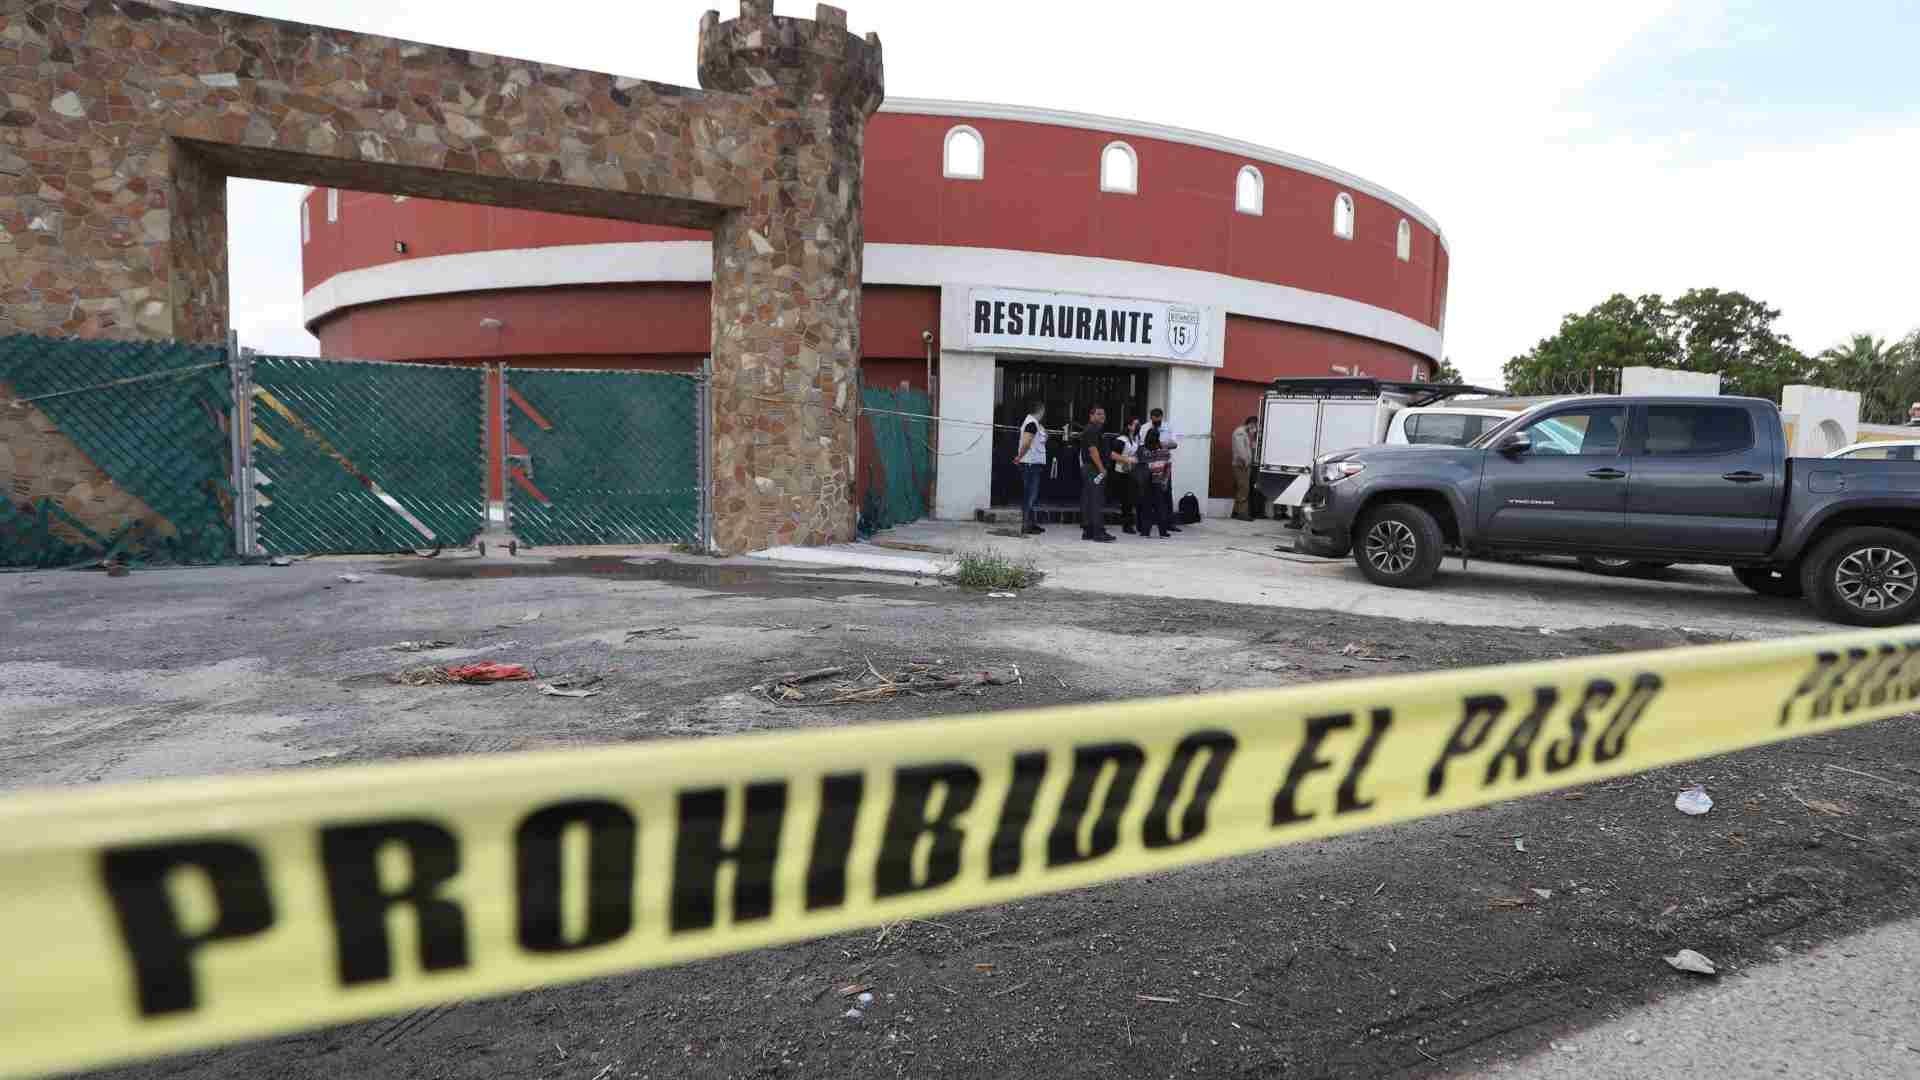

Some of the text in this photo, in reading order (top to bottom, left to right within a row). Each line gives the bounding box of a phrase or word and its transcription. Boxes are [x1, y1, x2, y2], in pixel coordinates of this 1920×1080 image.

[974, 299, 1153, 345] RESTAURANTE
[97, 671, 1663, 1019] PROHIBIDO EL PASO
